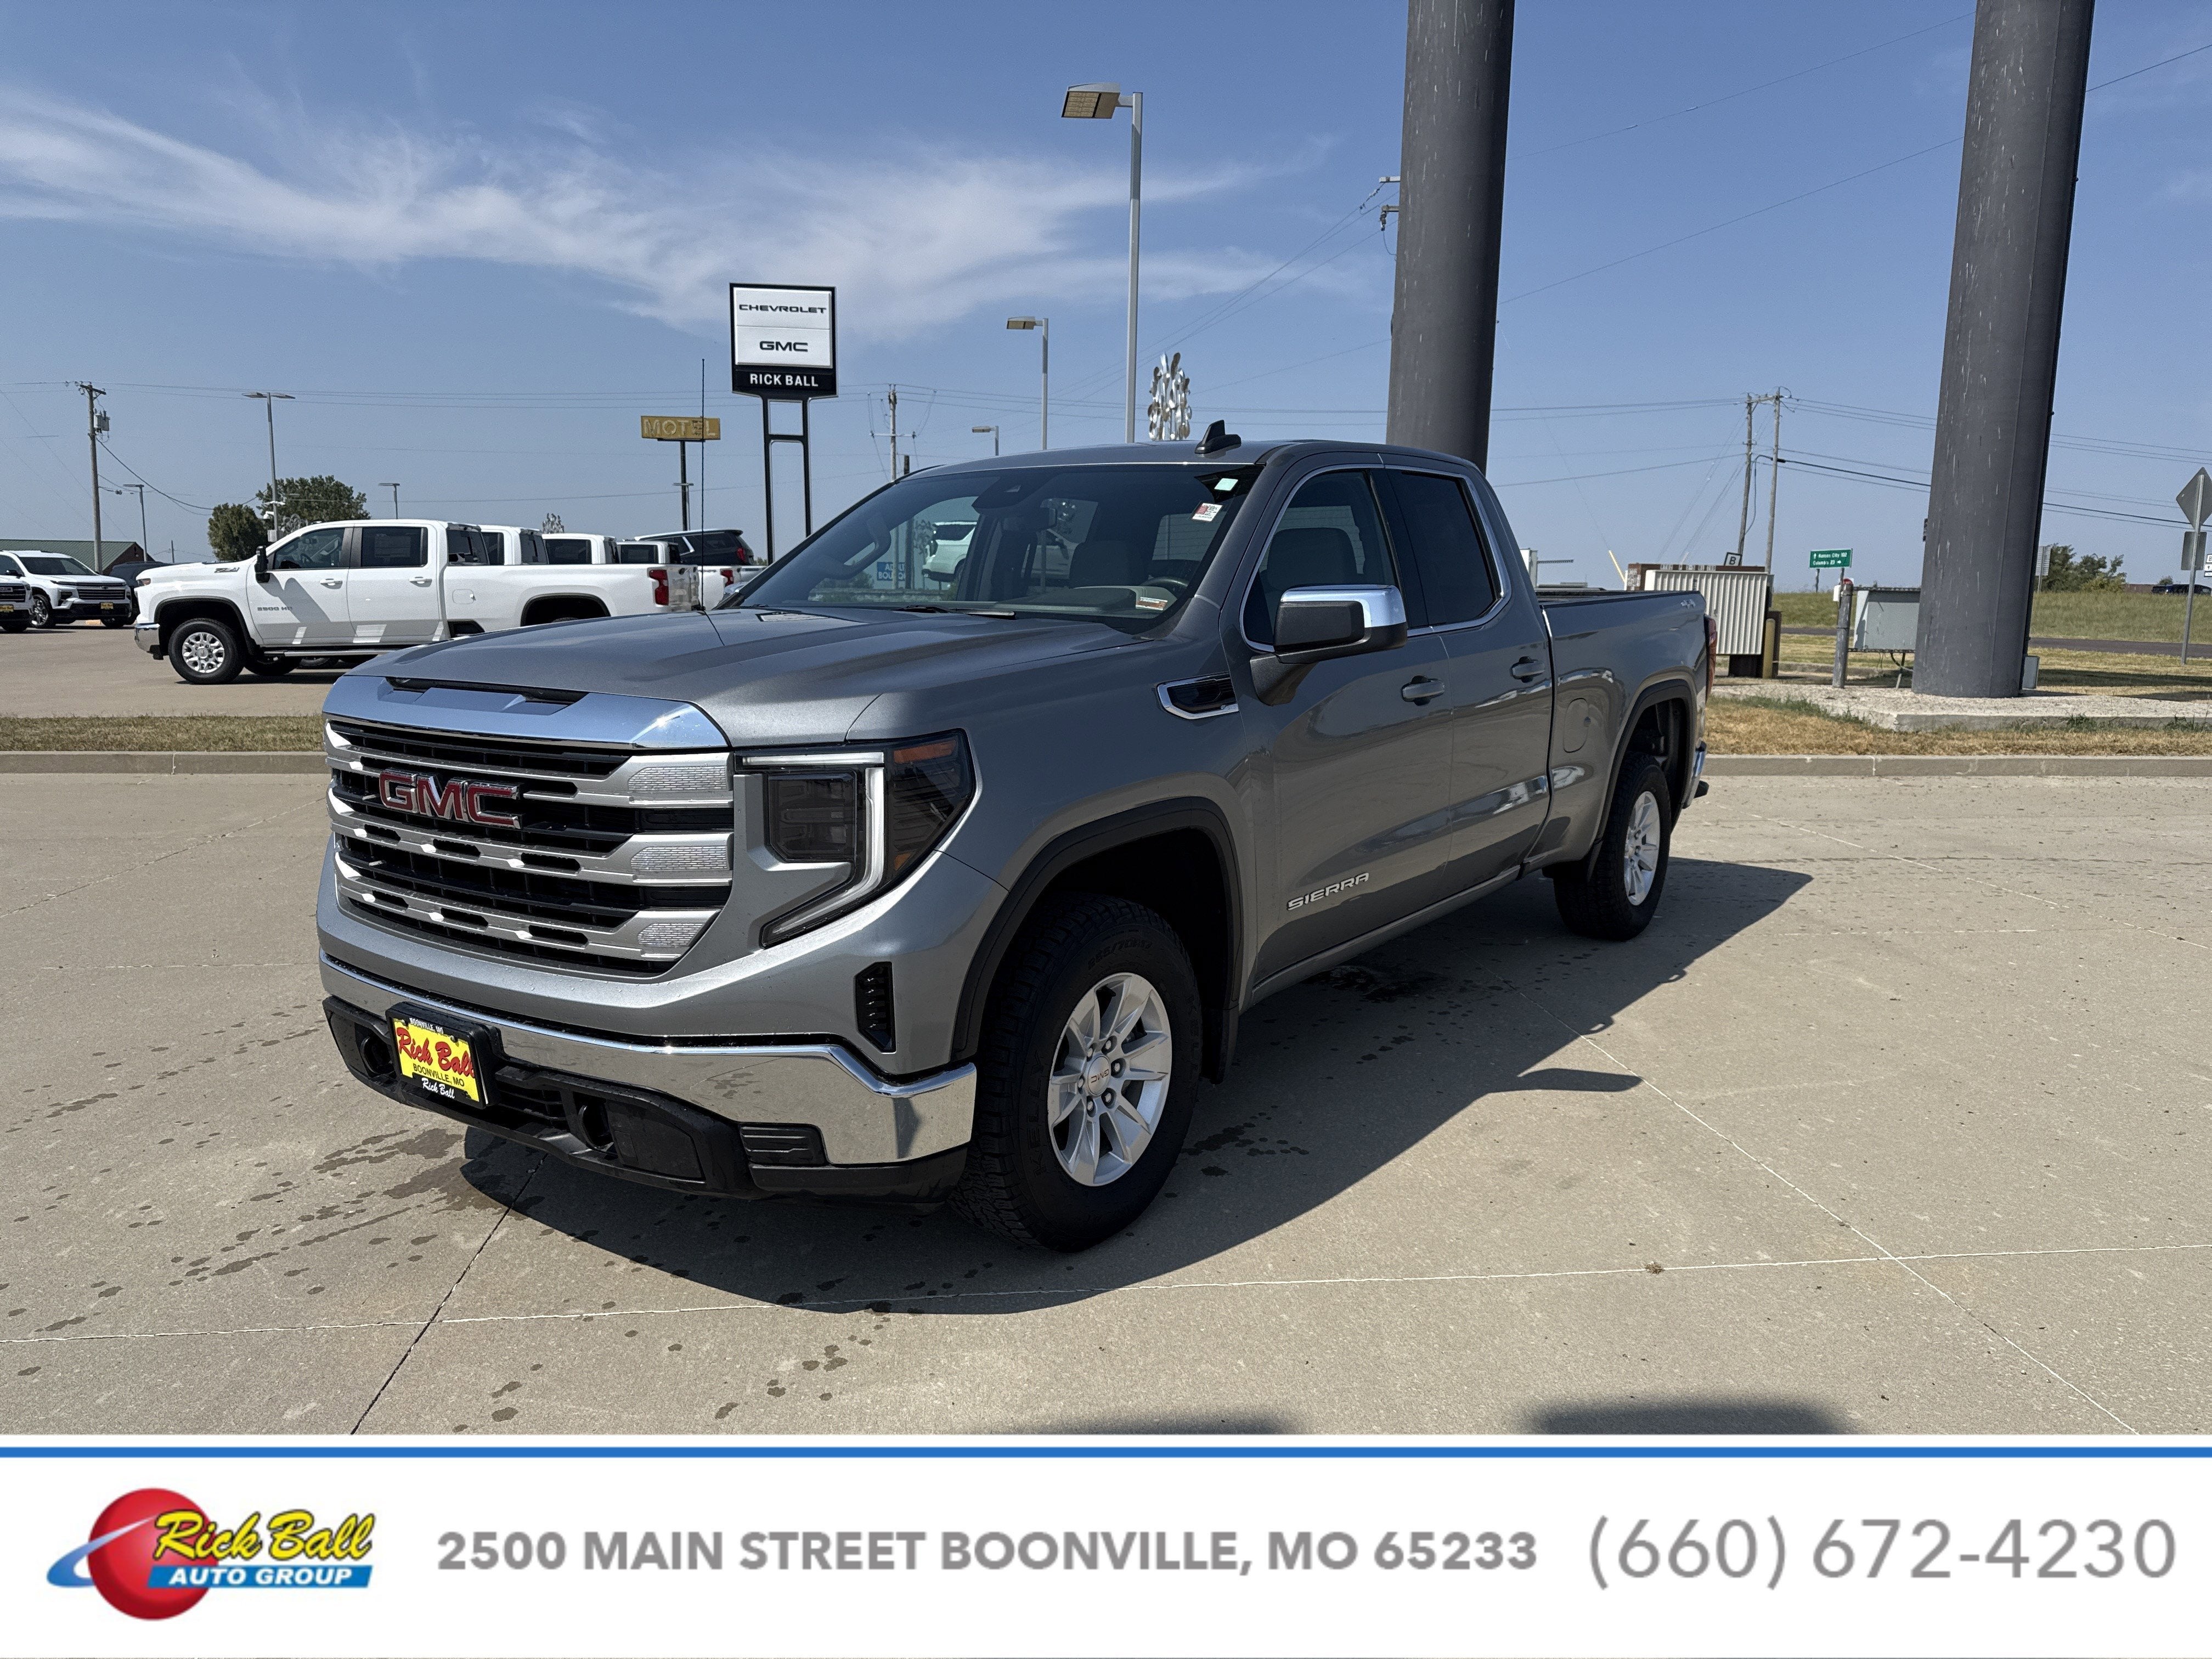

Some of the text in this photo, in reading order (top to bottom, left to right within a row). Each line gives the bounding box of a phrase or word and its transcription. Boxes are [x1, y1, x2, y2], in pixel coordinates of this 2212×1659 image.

[739, 304, 827, 314] CHEVROLET
[759, 341, 808, 352] GMC
[749, 374, 819, 387] RICK BALL
[644, 419, 715, 436] MOTEL
[1729, 556, 1737, 565] B
[379, 769, 522, 830] GMC
[1286, 872, 1369, 911] SIERRA
[396, 1027, 475, 1079] Rick Ball
[413, 1063, 465, 1087] BOONVILLE, MO
[421, 1077, 455, 1099] Rick Ball
